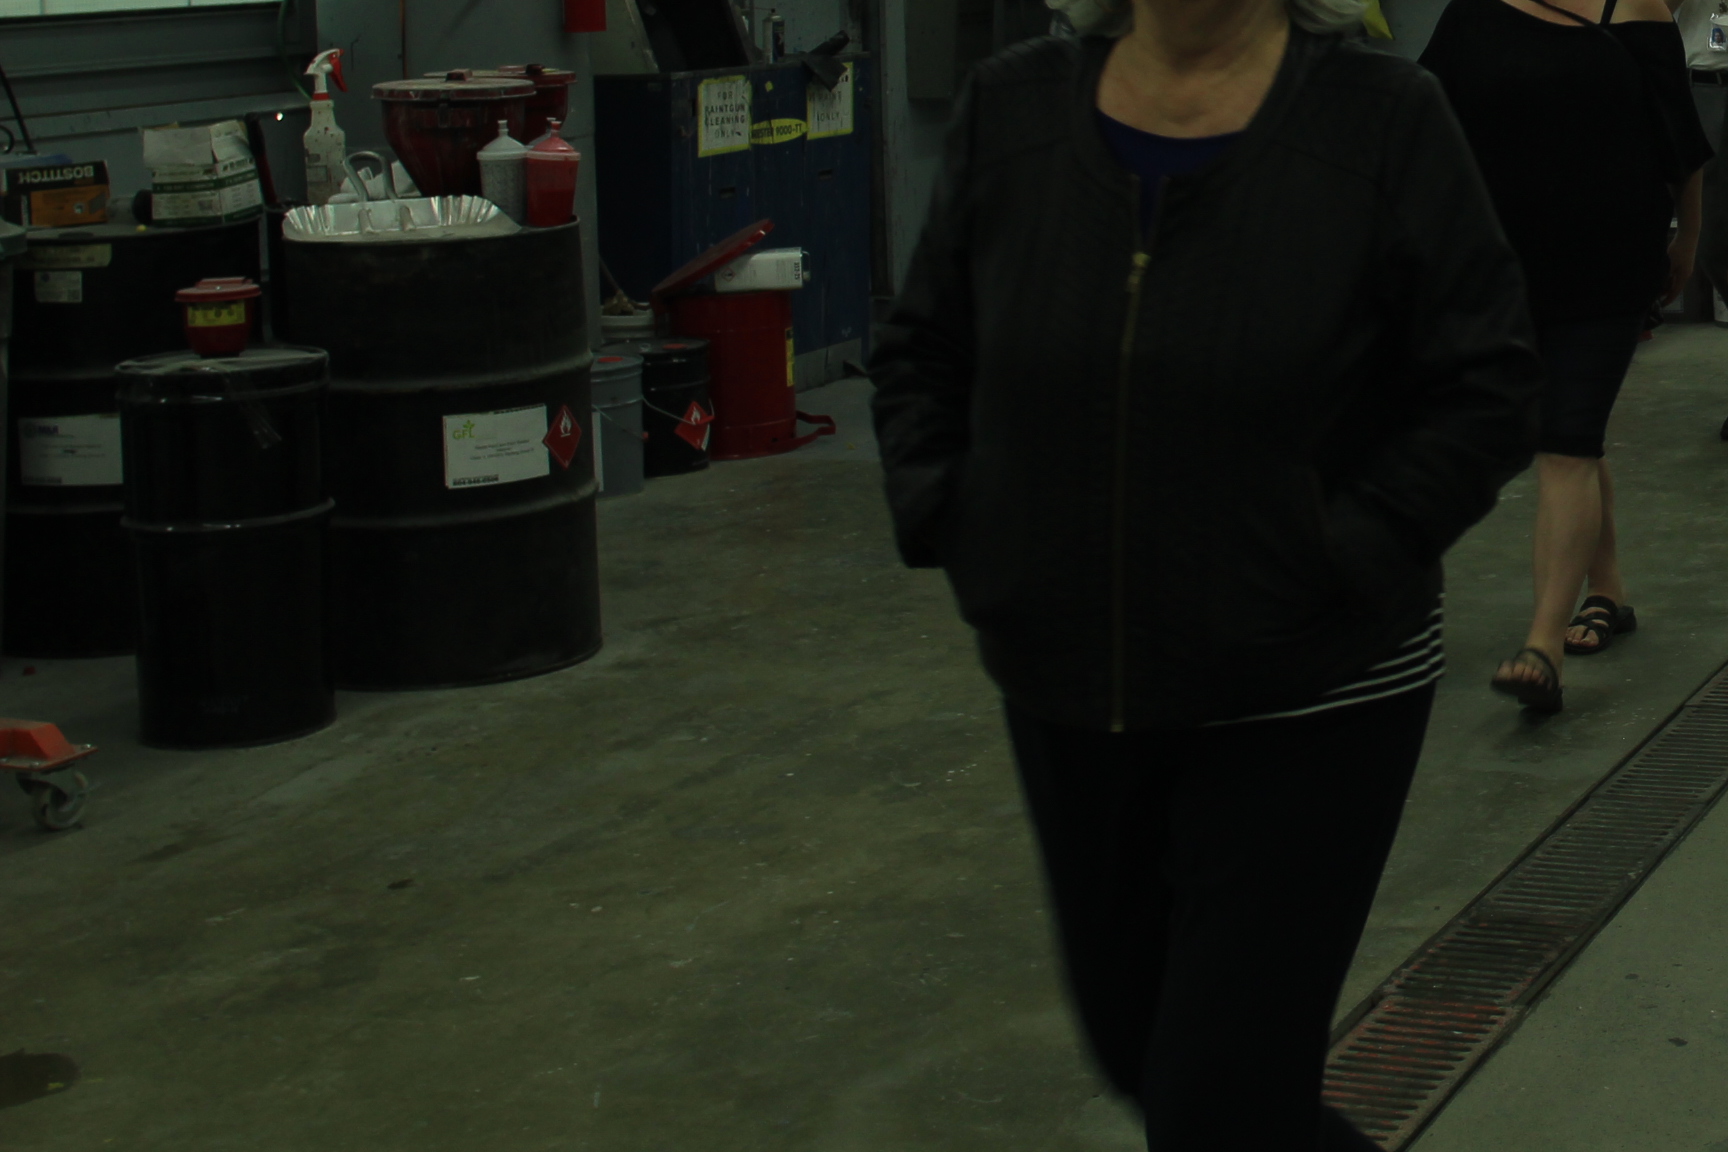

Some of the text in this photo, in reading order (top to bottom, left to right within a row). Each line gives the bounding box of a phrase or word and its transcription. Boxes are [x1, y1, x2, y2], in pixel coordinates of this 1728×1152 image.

[717, 91, 733, 101] FOR
[704, 115, 746, 126] CLEANING
[18, 165, 95, 184] BOSTITCH
